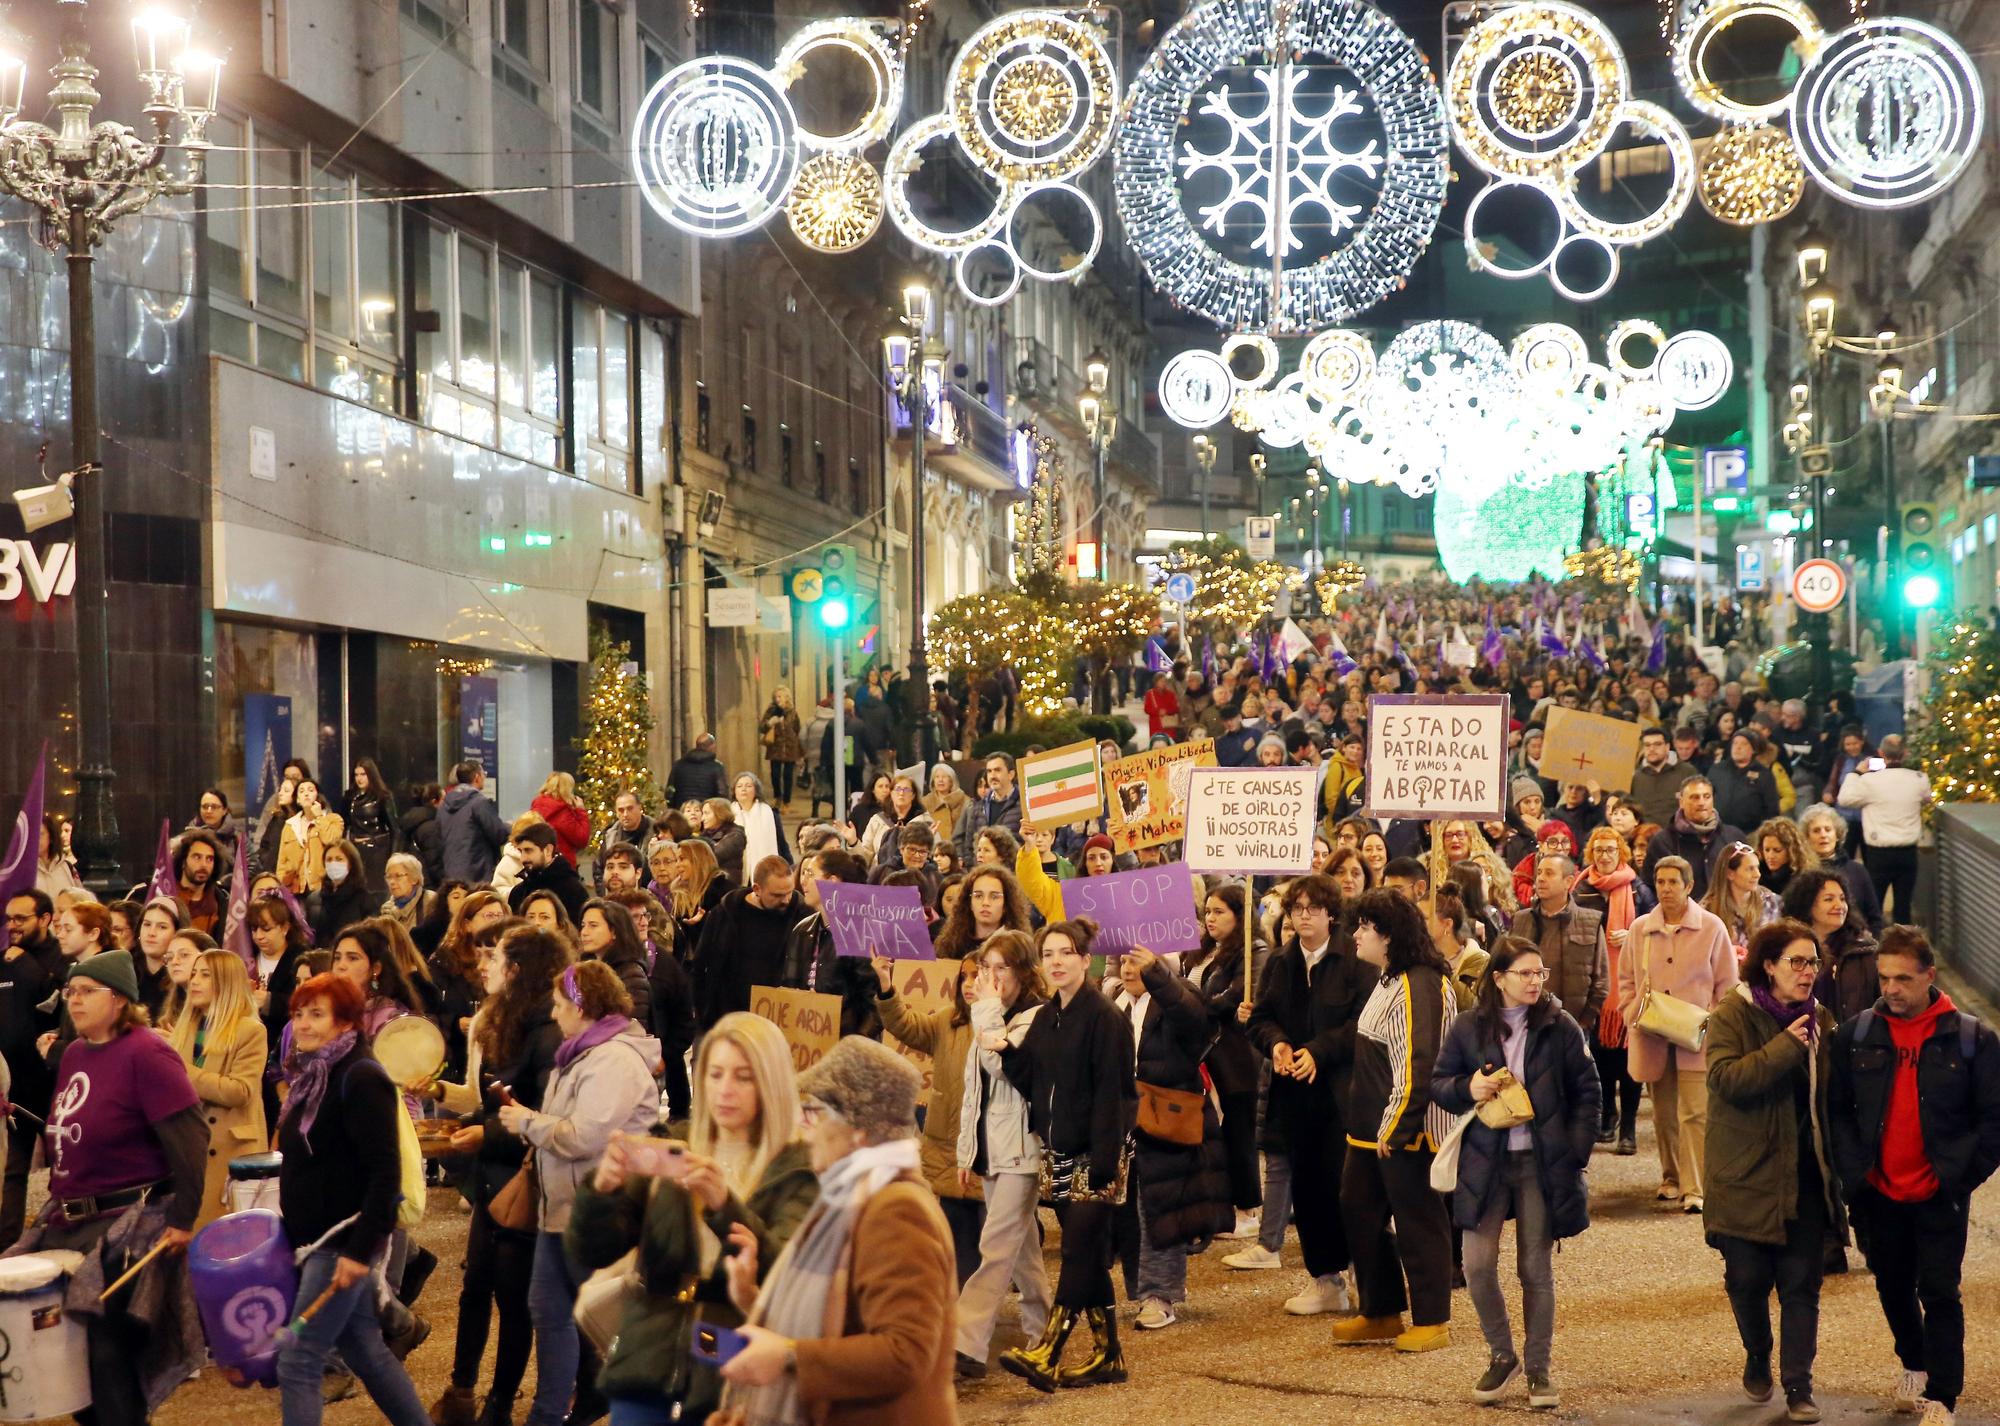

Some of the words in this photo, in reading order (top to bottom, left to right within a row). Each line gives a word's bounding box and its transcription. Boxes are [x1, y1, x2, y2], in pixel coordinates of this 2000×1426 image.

[1802, 576, 1833, 592] 40
[1383, 716, 1482, 737] ESTADO
[1384, 740, 1488, 760] PATRIARCAL
[1396, 759, 1409, 772] TE
[1415, 760, 1448, 772] VAMOS
[1453, 762, 1462, 772] A
[1243, 780, 1303, 796] CANSAS
[1222, 802, 1240, 816] DE
[1206, 844, 1225, 858] DE
[1080, 874, 1173, 912] STOP
[834, 916, 920, 955] MATA
[795, 1007, 832, 1037] ARDA
